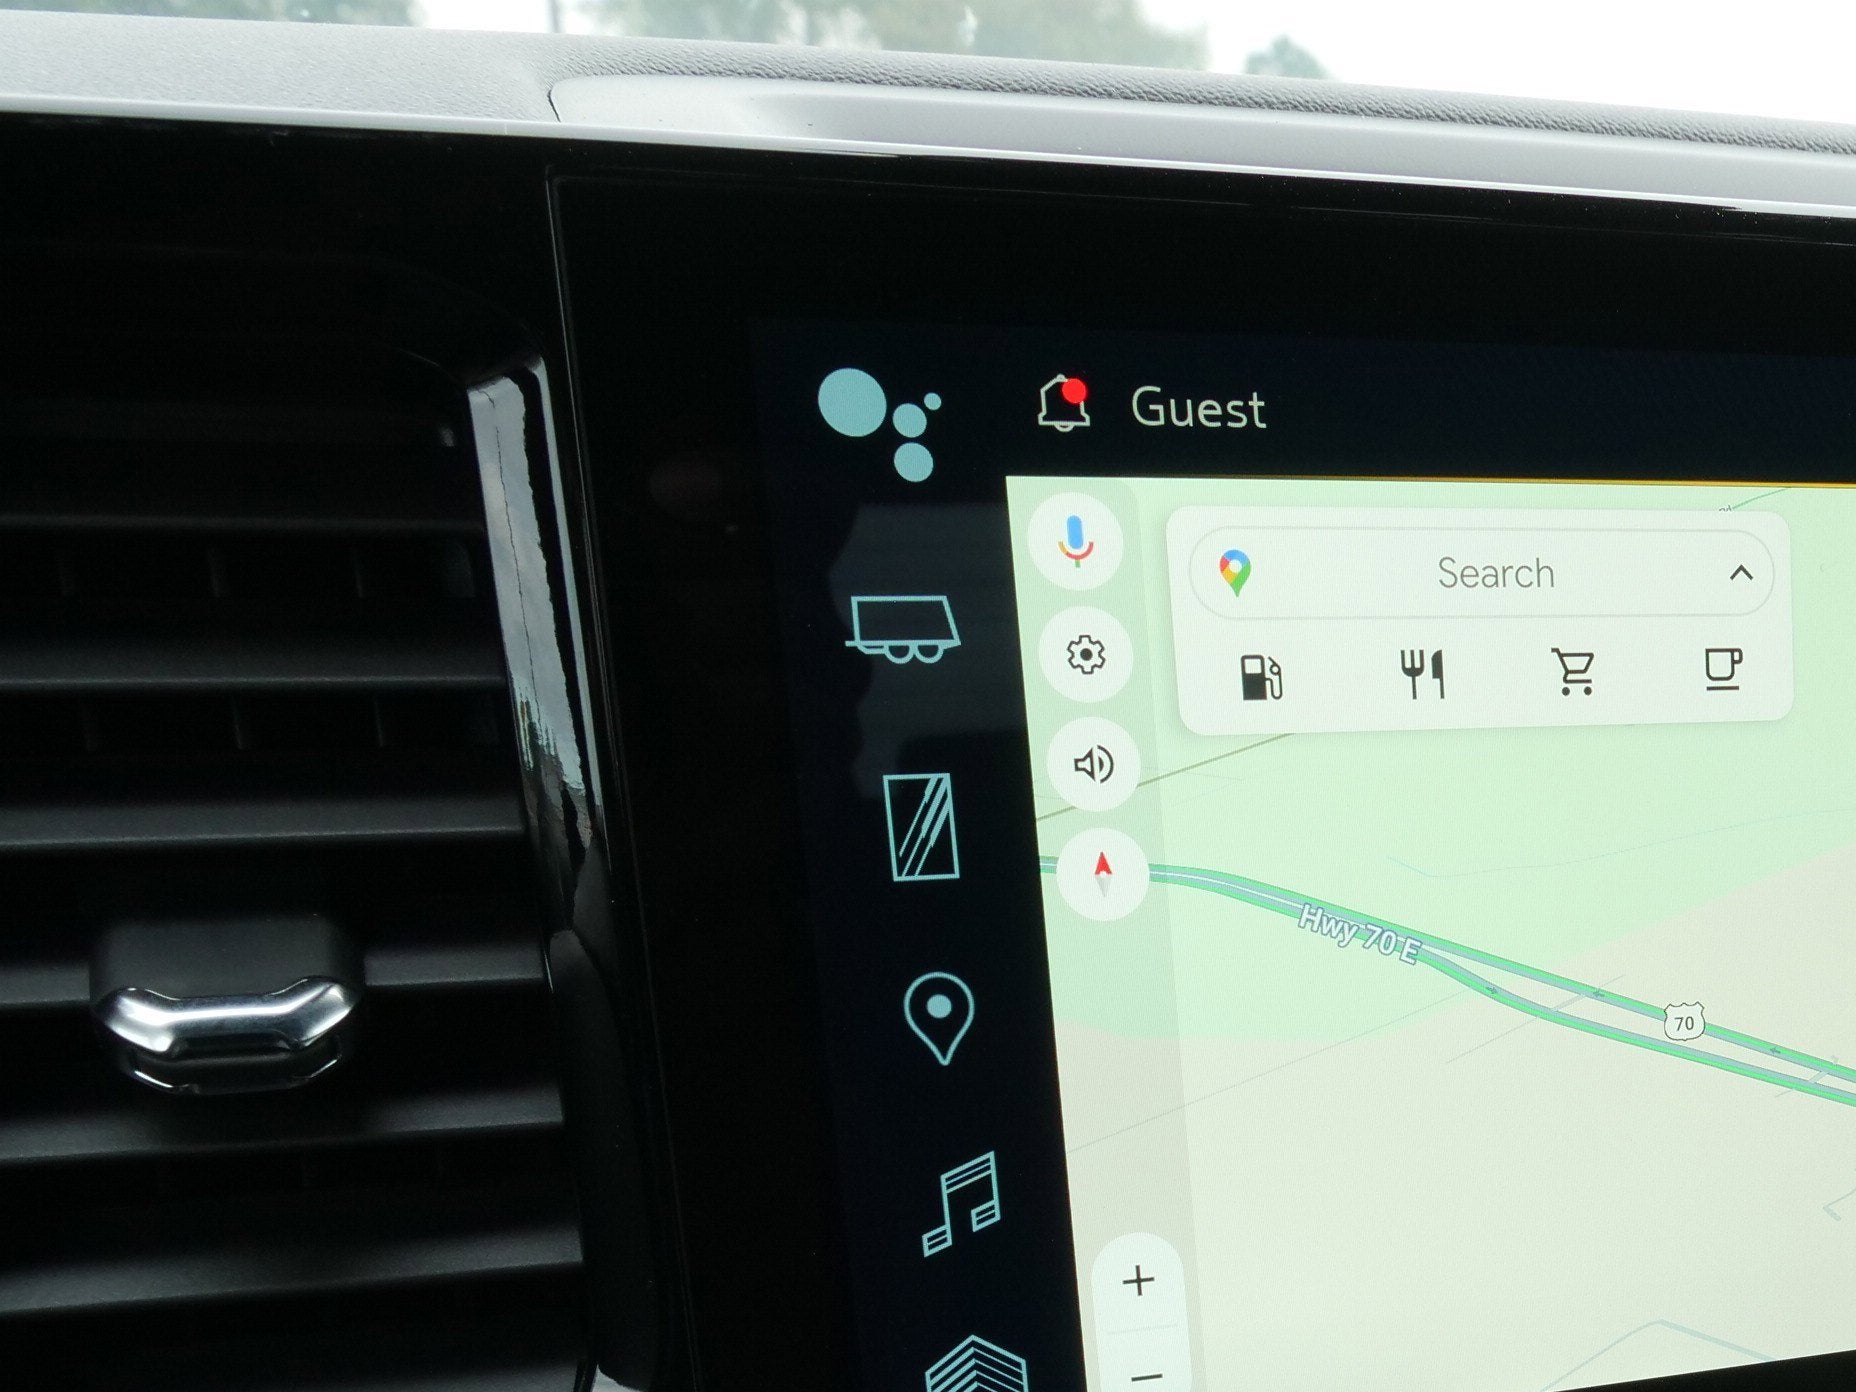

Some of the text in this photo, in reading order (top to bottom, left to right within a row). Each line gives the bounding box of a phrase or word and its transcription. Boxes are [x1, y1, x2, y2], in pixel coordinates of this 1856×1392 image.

[1131, 385, 1268, 429] Guest
[1438, 556, 1555, 589] Search
[1298, 903, 1423, 966] Hwy 70 E
[1673, 1015, 1695, 1032] 70
